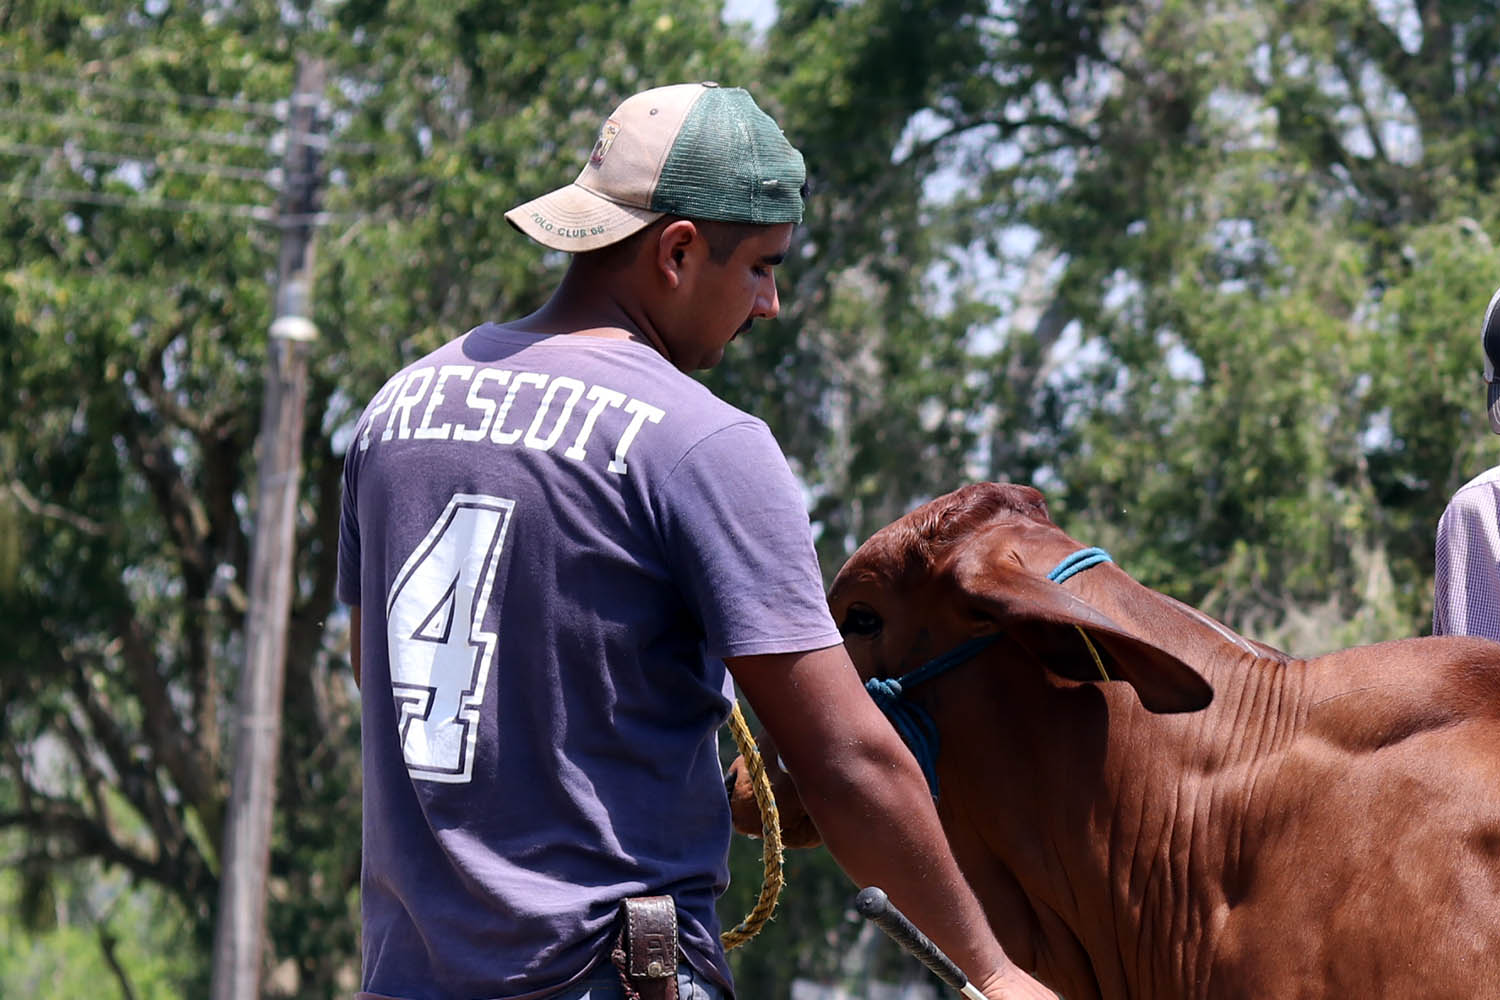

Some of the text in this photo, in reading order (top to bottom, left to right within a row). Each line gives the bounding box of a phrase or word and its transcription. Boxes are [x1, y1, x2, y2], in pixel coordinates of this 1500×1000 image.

[530, 212, 553, 231] POLO
[558, 227, 587, 238] CLUB
[360, 365, 665, 474] PRESCOTT
[387, 493, 515, 784] 4
